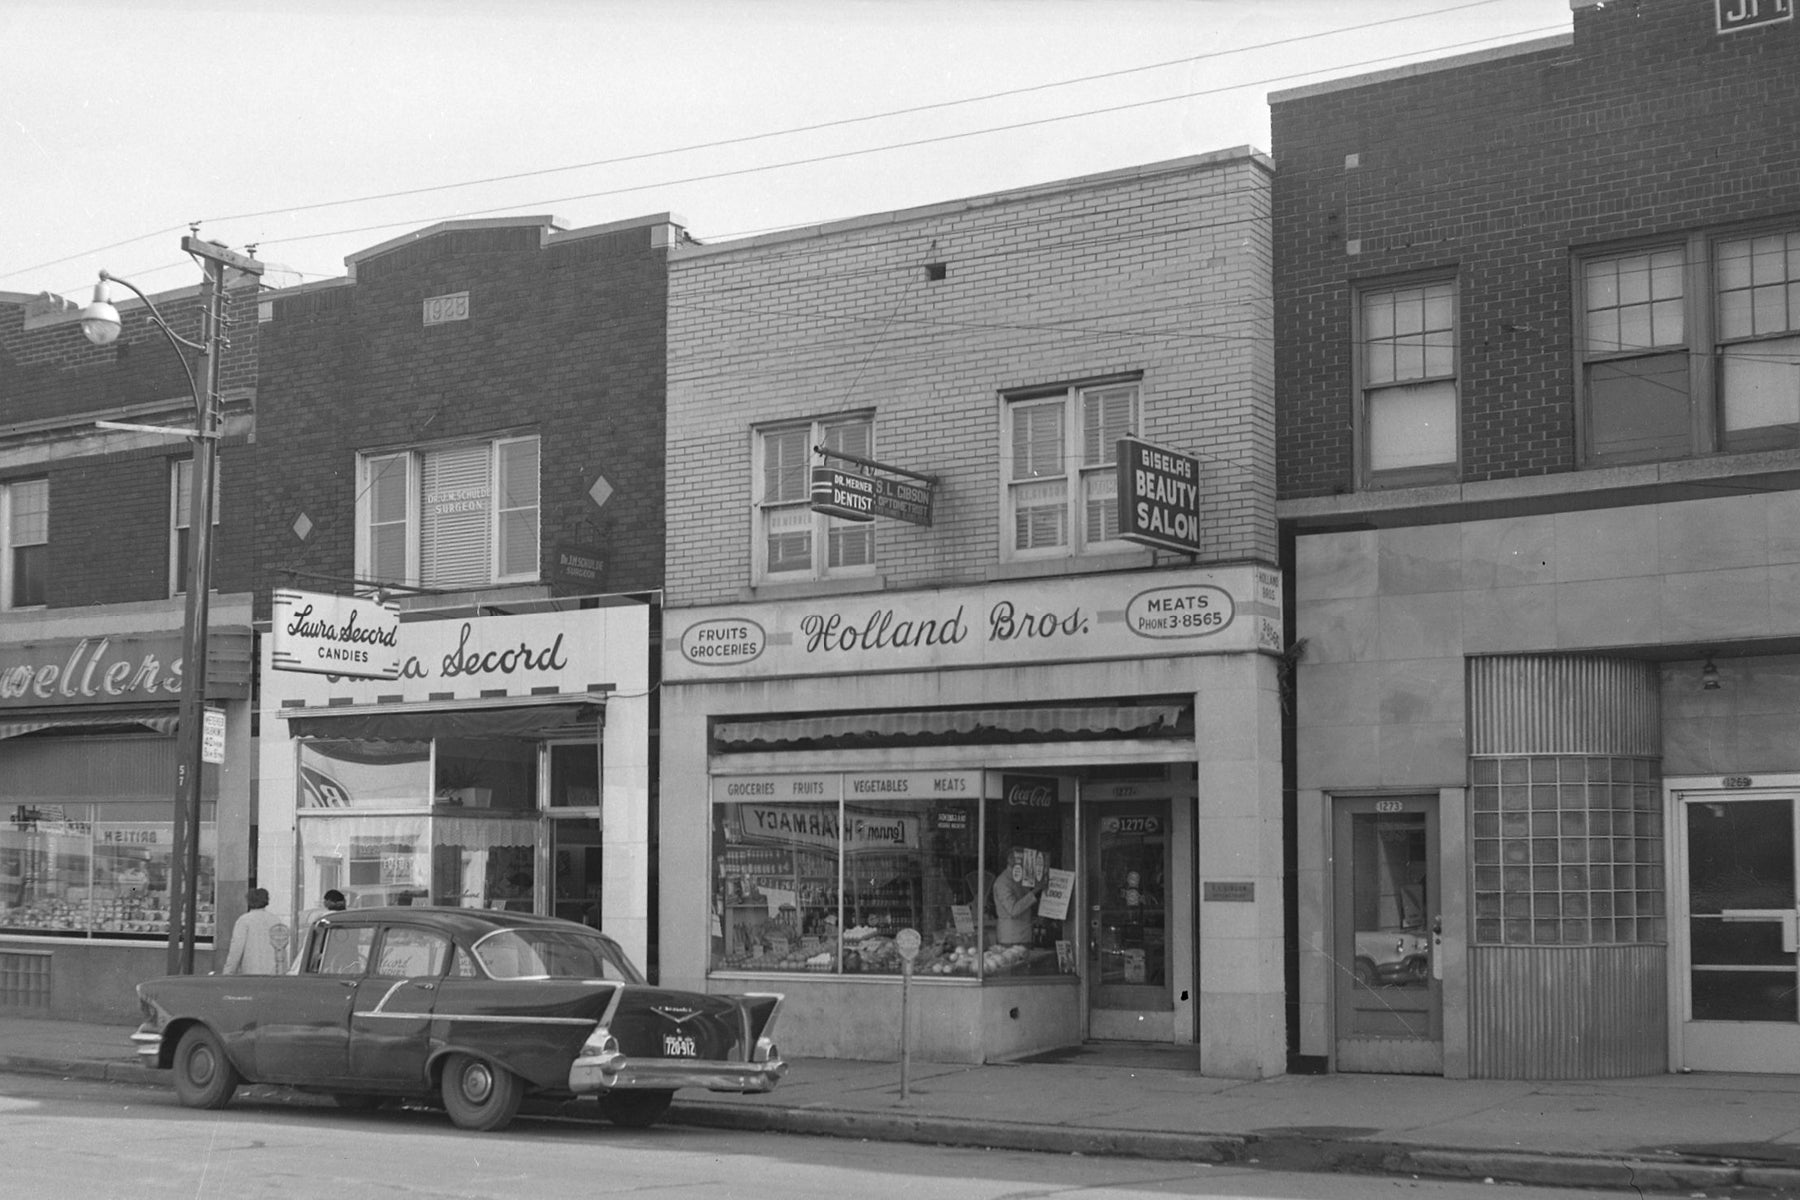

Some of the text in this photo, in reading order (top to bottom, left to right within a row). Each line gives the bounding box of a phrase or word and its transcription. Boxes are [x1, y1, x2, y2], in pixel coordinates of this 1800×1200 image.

[1141, 449, 1191, 478] GISELA'S
[834, 489, 873, 510] DENTIST
[897, 485, 930, 505] GIBSON
[1136, 469, 1197, 511] BEAUTY
[435, 500, 482, 514] SURGEON
[1137, 502, 1198, 542] SALON
[1148, 595, 1209, 612] MEATS
[287, 604, 398, 648] Laura Secord
[698, 627, 747, 641] FRUITS
[800, 600, 1088, 653] Holland Bros.
[318, 646, 368, 662] CANDIES
[440, 622, 568, 677] Secord
[690, 642, 757, 658] GROCERIES
[727, 778, 966, 796] GROCERIES FRUITS VEGETABLES MEATS
[1121, 818, 1145, 832] 1277
